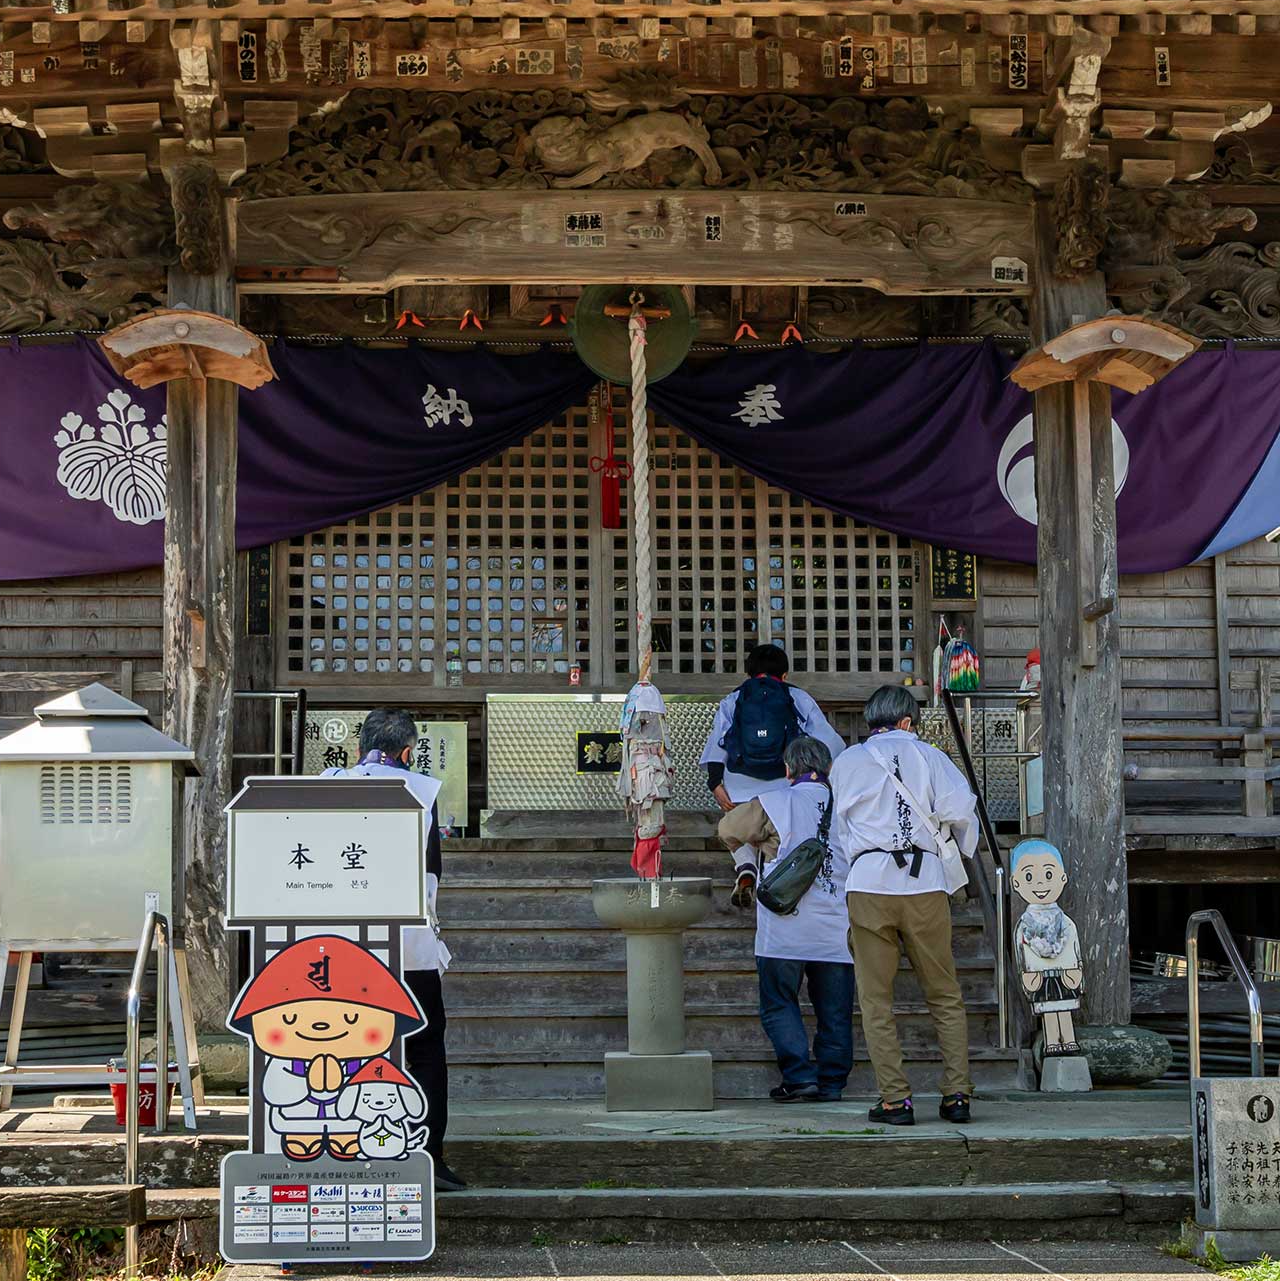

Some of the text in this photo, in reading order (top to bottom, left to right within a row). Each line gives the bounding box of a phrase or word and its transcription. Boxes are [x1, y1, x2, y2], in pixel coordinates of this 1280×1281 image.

[421, 383, 473, 427] 納
[731, 384, 784, 427] 奉
[993, 720, 1012, 738] 納
[288, 842, 368, 870] 本堂
[307, 882, 333, 890] Temple
[351, 880, 369, 890] 본당
[1241, 1141, 1256, 1205] 家内安全
[1256, 1141, 1270, 1205] 先祖供養
[313, 1185, 343, 1197] Asahi
